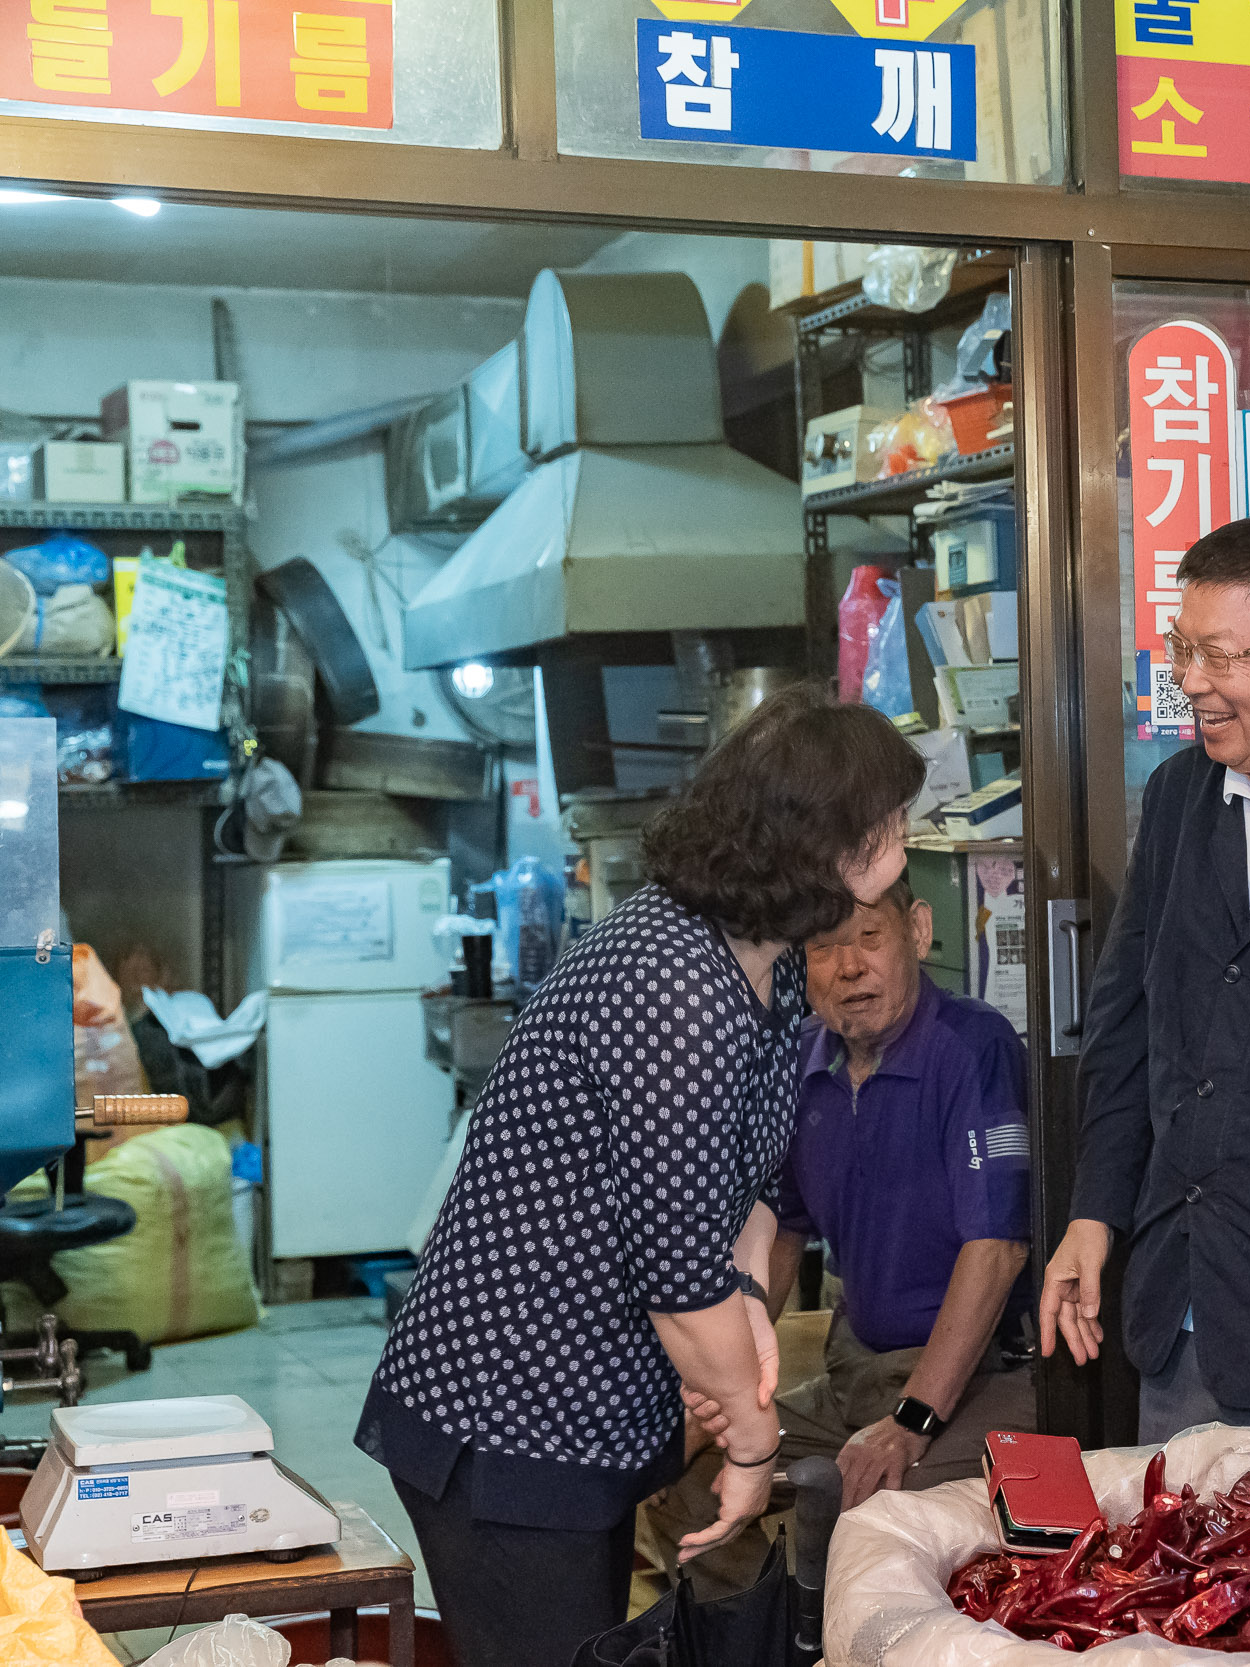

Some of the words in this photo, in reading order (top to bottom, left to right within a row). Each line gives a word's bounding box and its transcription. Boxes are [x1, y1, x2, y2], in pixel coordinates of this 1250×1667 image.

[26, 0, 371, 114] 들기름
[657, 31, 952, 151] 참깨
[142, 1513, 173, 1524] CAS
